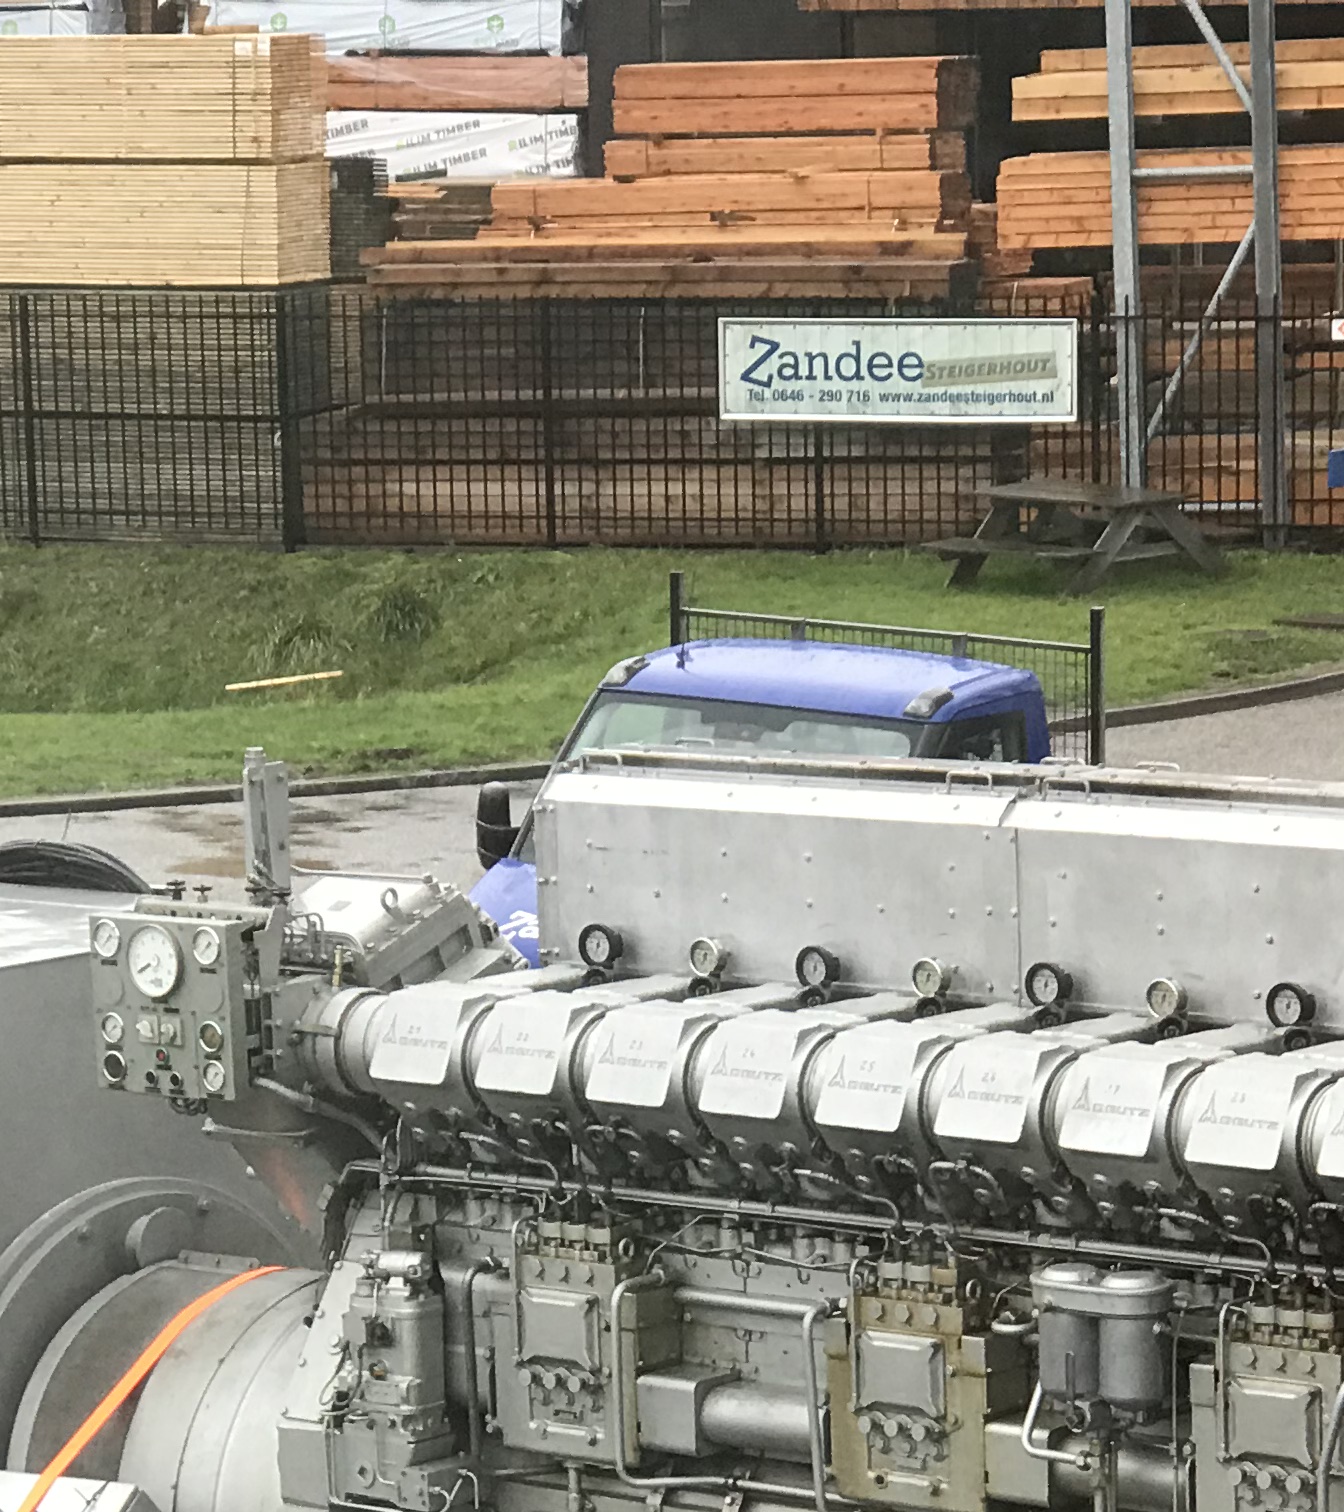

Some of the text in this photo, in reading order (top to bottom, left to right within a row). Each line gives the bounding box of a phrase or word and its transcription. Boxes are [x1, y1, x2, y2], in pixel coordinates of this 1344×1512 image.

[435, 119, 481, 140] TIMBER
[441, 147, 488, 170] TIMBER
[740, 334, 925, 389] Zandee
[747, 388, 769, 402] Tel.
[772, 389, 805, 402] 0646
[818, 389, 843, 402] 290
[846, 389, 872, 403] 716
[878, 389, 1054, 406] www.zandeesteigerhout.nl
